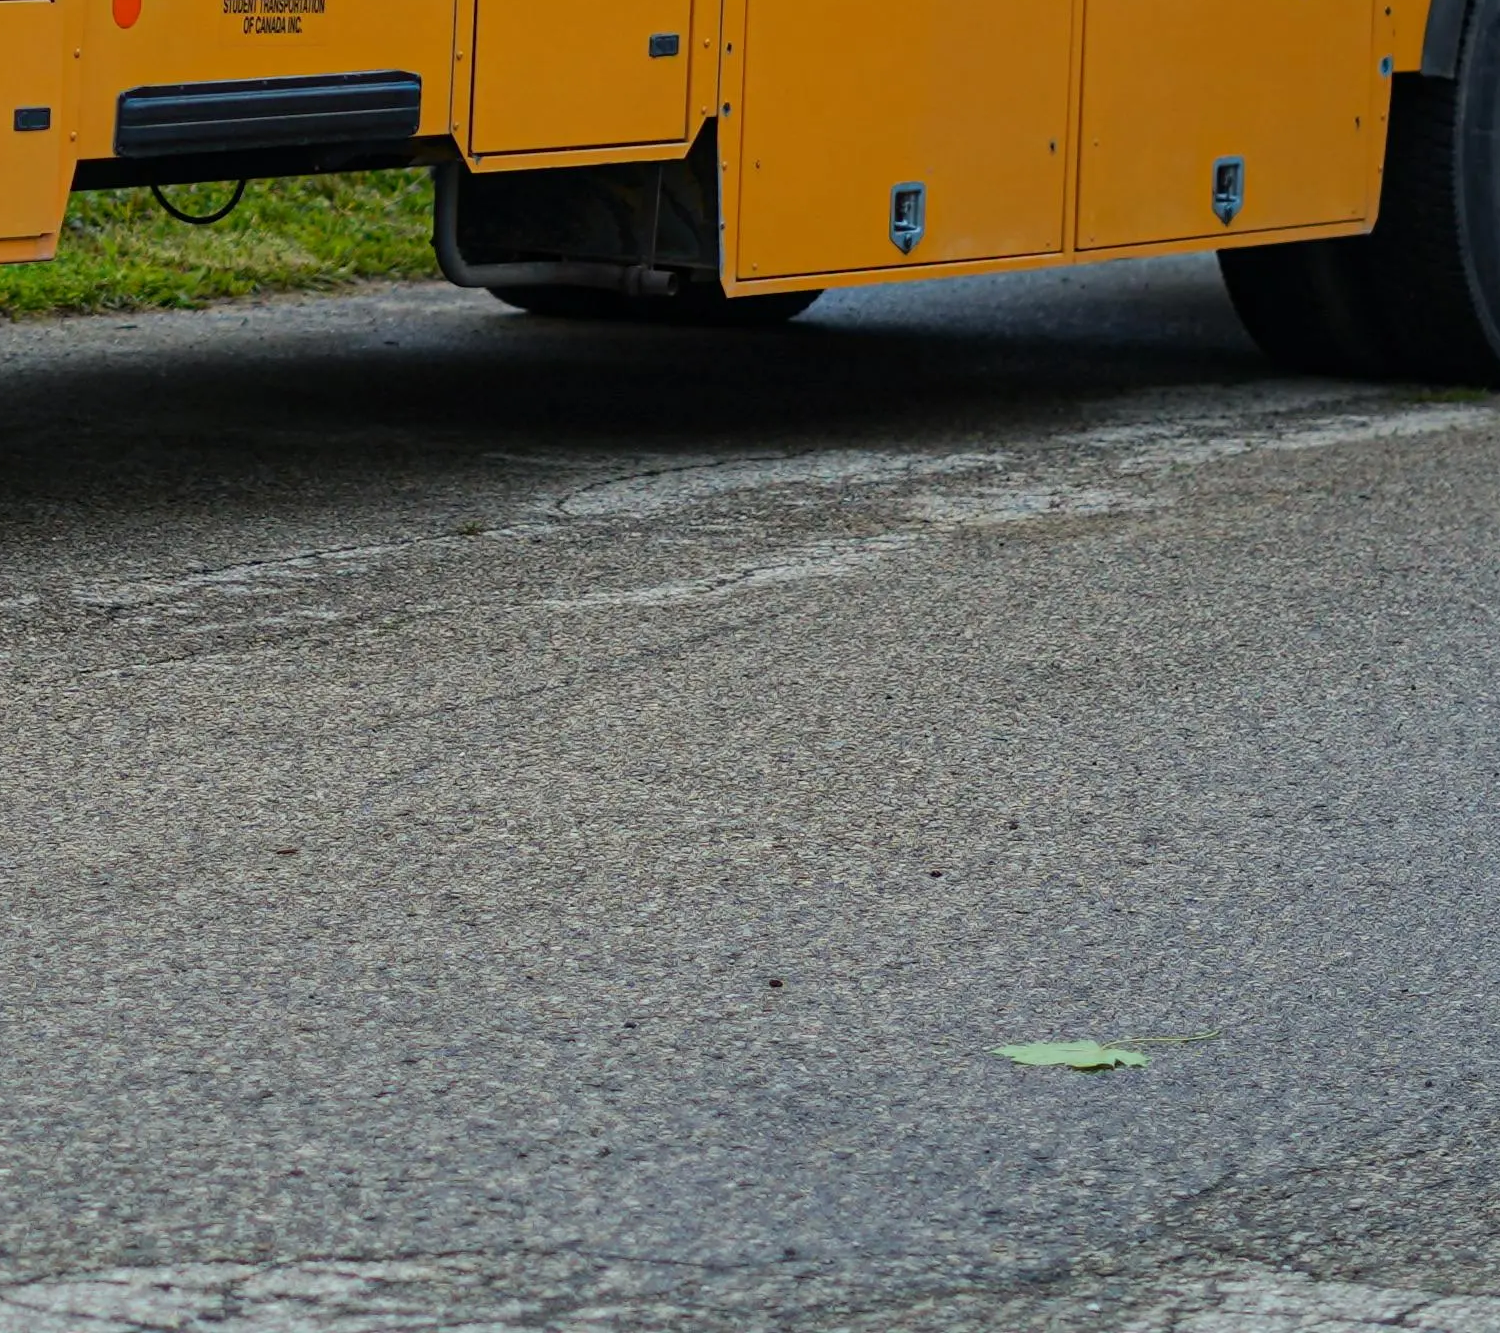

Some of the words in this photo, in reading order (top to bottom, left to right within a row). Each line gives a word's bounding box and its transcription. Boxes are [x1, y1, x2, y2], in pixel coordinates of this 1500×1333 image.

[243, 16, 255, 34] OF
[255, 16, 287, 34] CANADA
[287, 16, 303, 34] INC.
